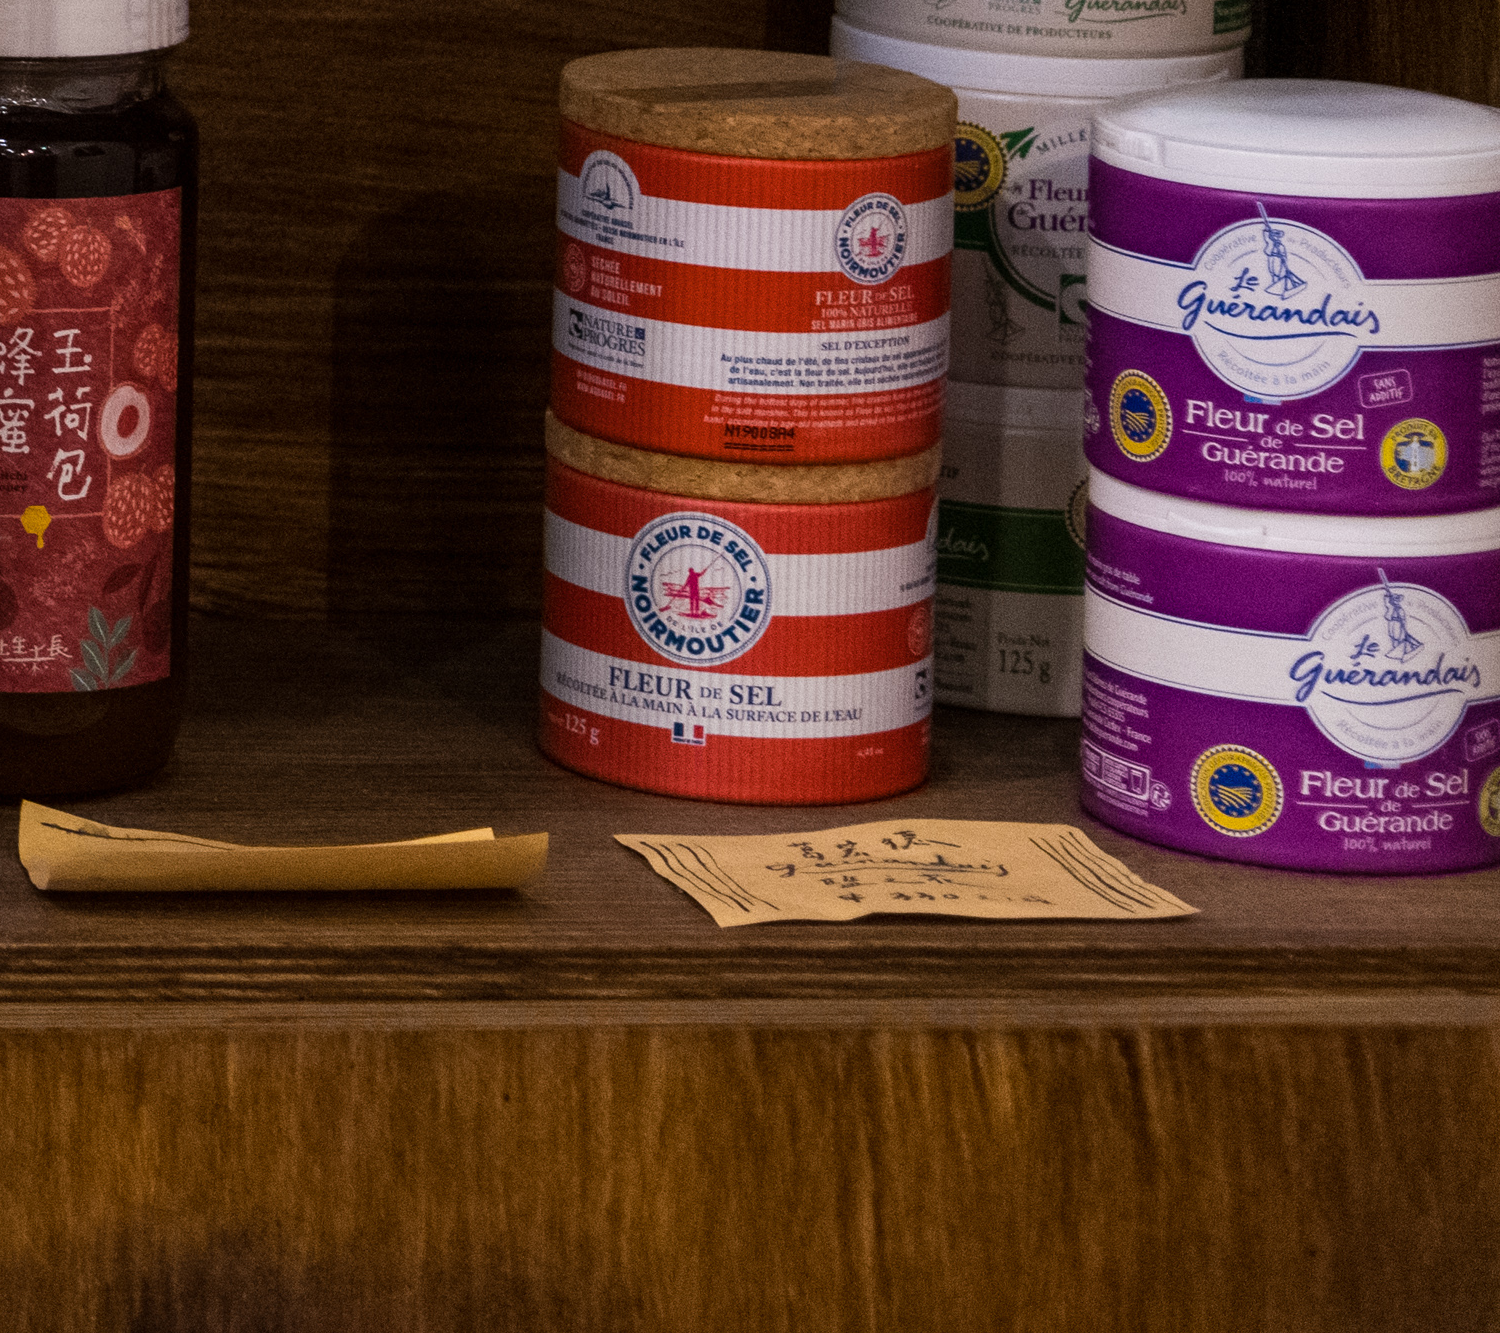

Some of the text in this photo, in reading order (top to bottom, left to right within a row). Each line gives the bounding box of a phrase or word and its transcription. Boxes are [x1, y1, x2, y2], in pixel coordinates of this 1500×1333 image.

[838, 232, 906, 279] NOIRMOUTIER
[1229, 267, 1260, 292] Le
[814, 285, 916, 306] FLEUR SEL
[1177, 280, 1381, 335] Guérandais
[582, 314, 635, 339] NATURE
[582, 327, 646, 357] PROGRES
[820, 335, 911, 352] SEL D'EXCEPTION
[1372, 376, 1396, 389] SANS
[43, 327, 94, 502] 玉荷包
[1185, 399, 1365, 440] Fleur de Sel
[1259, 435, 1284, 449] de
[1201, 441, 1345, 474] Guérande
[1223, 469, 1318, 491] 100% naturel
[641, 525, 753, 574] FLEUR DE SEL
[631, 573, 765, 656] NOIRMOUTIER
[1350, 634, 1380, 659] Le
[608, 665, 783, 708] FLEUR DE SEL
[1288, 649, 1482, 703] Guérandais
[619, 693, 863, 724] LA MAIN À LA SURFACE DE L'EAU
[562, 711, 587, 736] 125
[1299, 768, 1470, 798] Fleur de Sel
[1380, 797, 1402, 812] de
[1318, 810, 1454, 834] Guérande
[1342, 836, 1432, 852] 100% naturel
